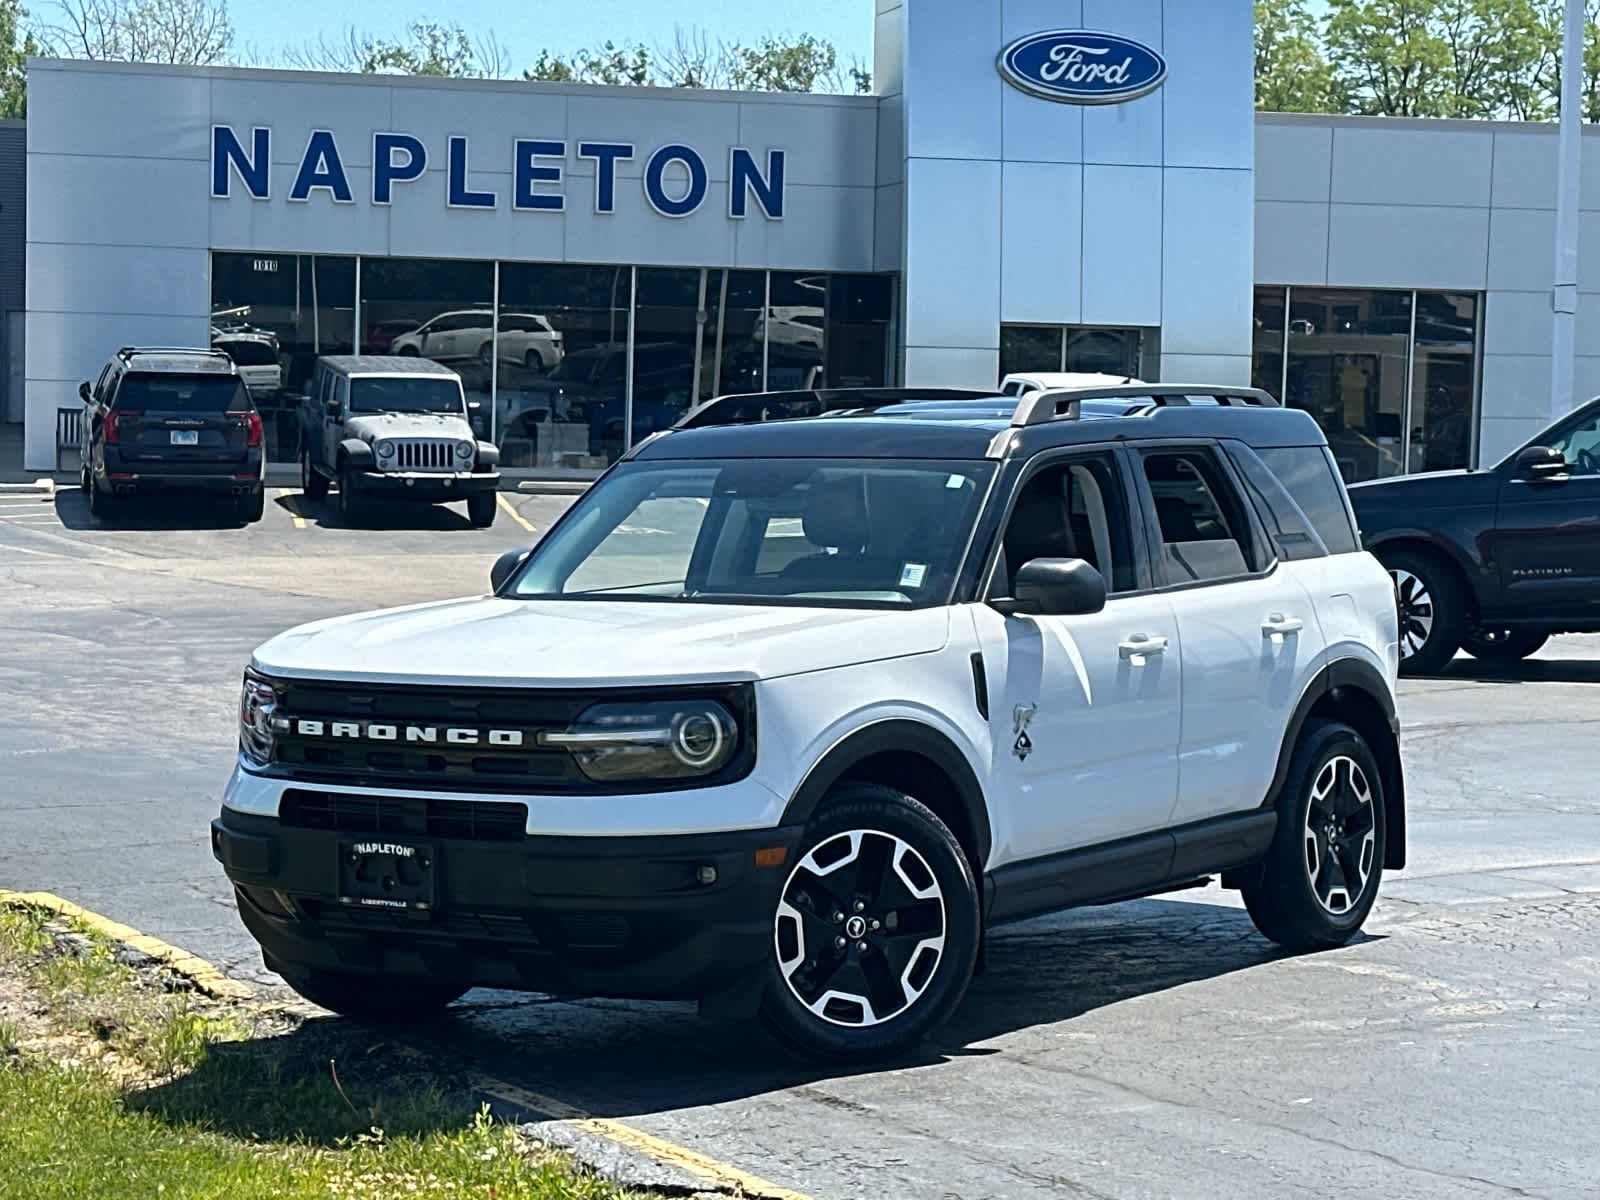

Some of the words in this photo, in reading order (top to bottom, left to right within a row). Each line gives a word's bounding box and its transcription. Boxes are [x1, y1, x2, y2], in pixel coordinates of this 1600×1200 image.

[1039, 44, 1133, 84] Ford
[210, 124, 786, 220] NAPLETON
[254, 260, 278, 271] 1010
[1512, 567, 1573, 576] PLATINUM
[298, 719, 523, 746] BRONCO
[357, 842, 412, 857] NAPLETON
[361, 898, 407, 908] LIBERTYVILLE
